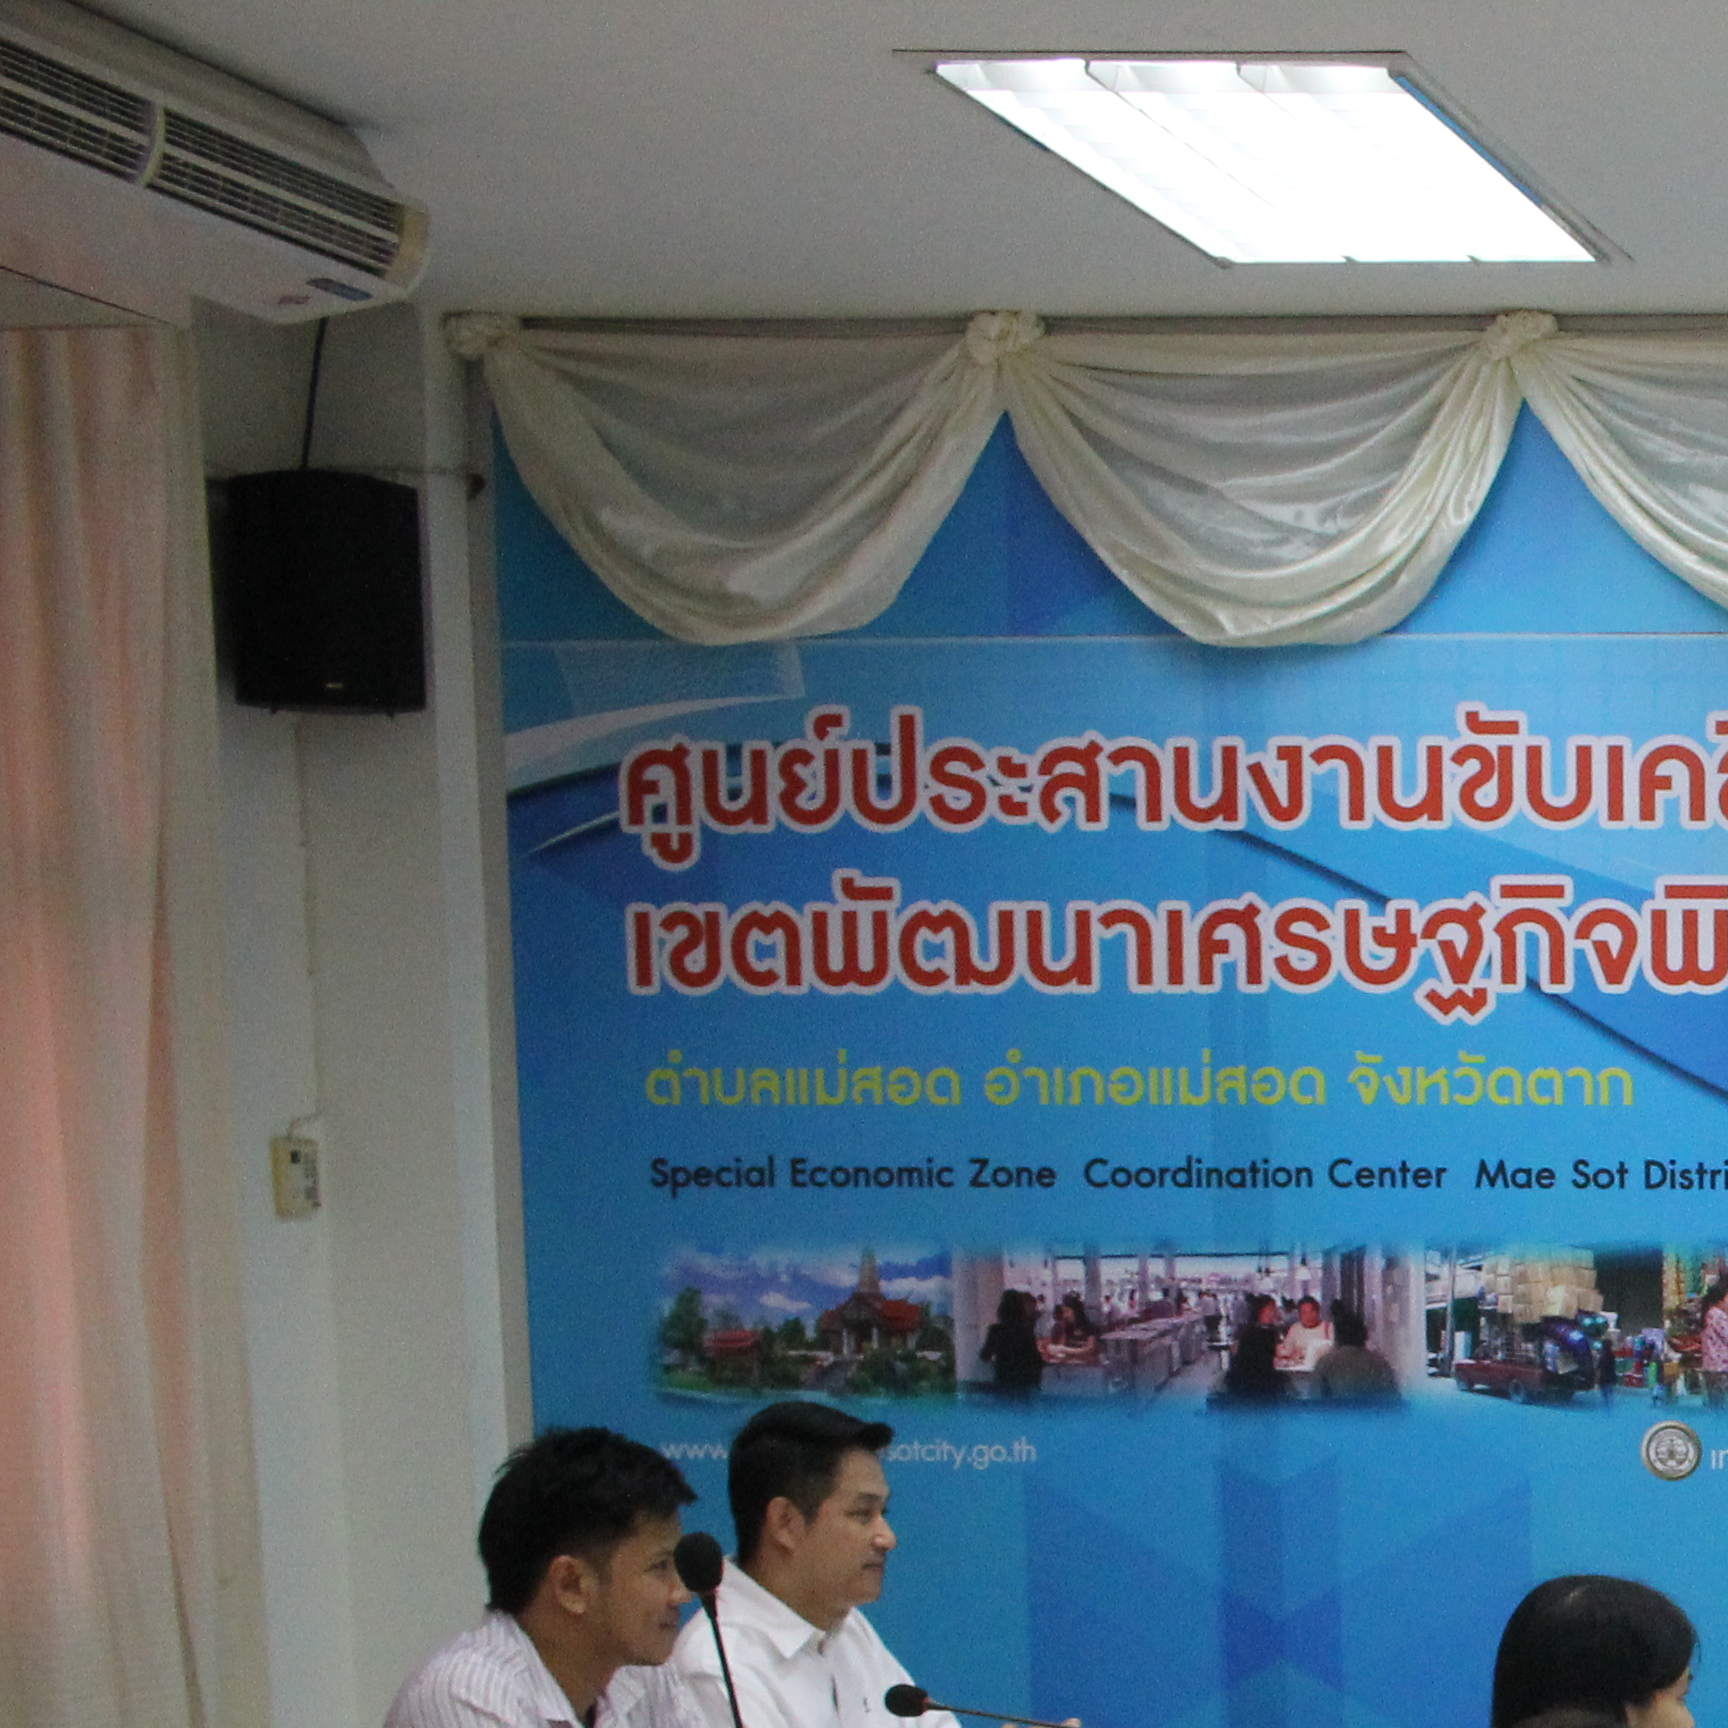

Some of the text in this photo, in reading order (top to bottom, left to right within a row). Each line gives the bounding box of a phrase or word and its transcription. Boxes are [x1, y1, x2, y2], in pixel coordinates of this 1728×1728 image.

[645, 1049, 1633, 1106] ตำบลแม่สอด อำเภอแม่สอด จังหวัดตาก
[651, 1157, 774, 1197] Special
[791, 1158, 953, 1190] Economic
[969, 1158, 1056, 1190] Zone
[1084, 1156, 1313, 1190] Coordination
[1329, 1158, 1446, 1190] Center
[1475, 1158, 1555, 1190] Mae
[1572, 1159, 1628, 1190] Sot
